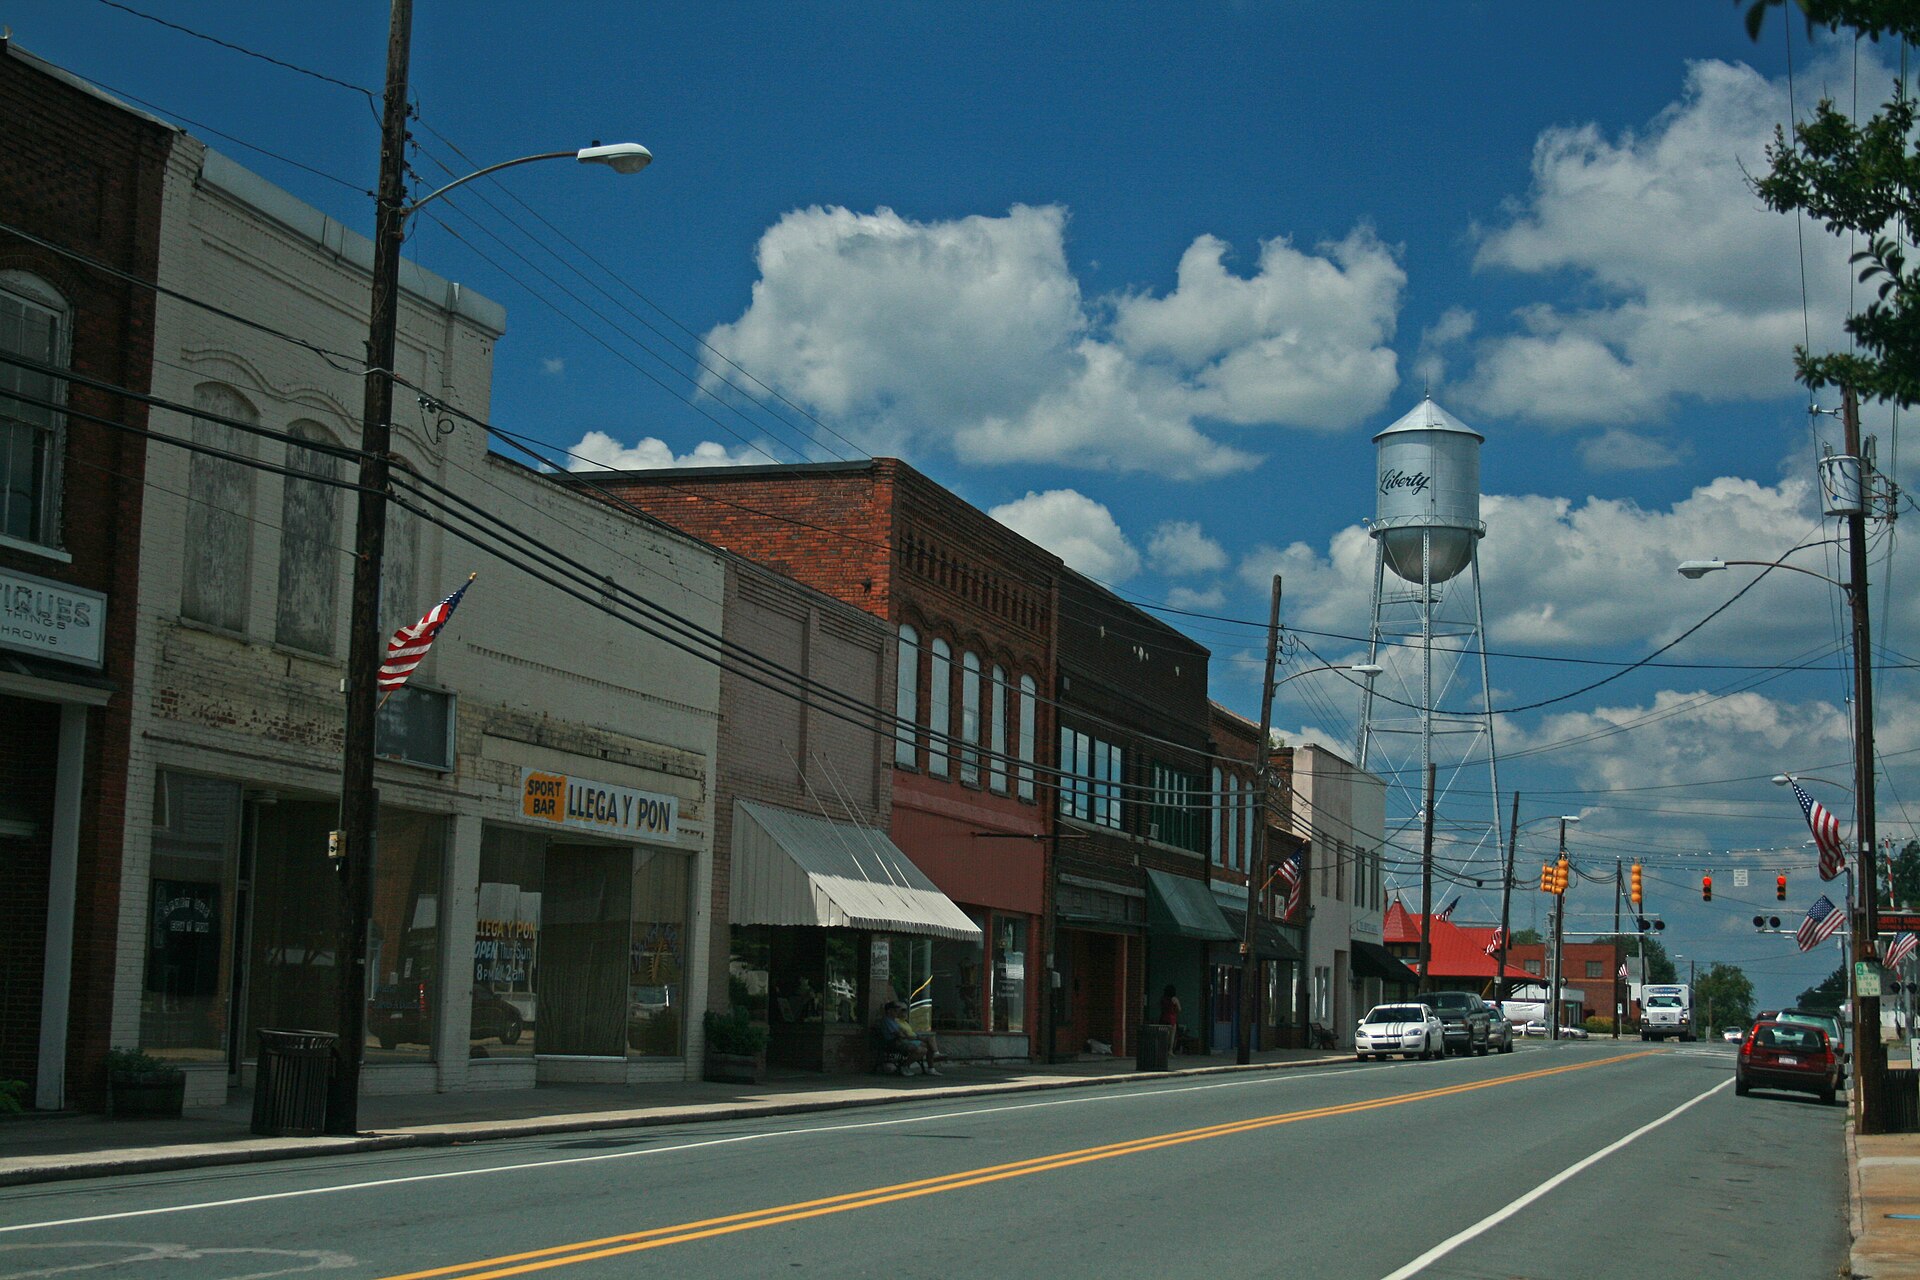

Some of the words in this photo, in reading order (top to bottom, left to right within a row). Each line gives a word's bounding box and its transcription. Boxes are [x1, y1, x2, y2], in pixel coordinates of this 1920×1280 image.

[1379, 468, 1431, 496] Liberty
[0, 583, 91, 628] IQUES
[5, 608, 66, 630] THINGS
[527, 779, 562, 797] SPORT
[533, 798, 556, 815] BAR
[567, 784, 618, 826] LLEGA
[623, 794, 633, 827] Y
[637, 797, 671, 833] PON
[516, 920, 536, 939] PON
[474, 940, 498, 959] OPEN
